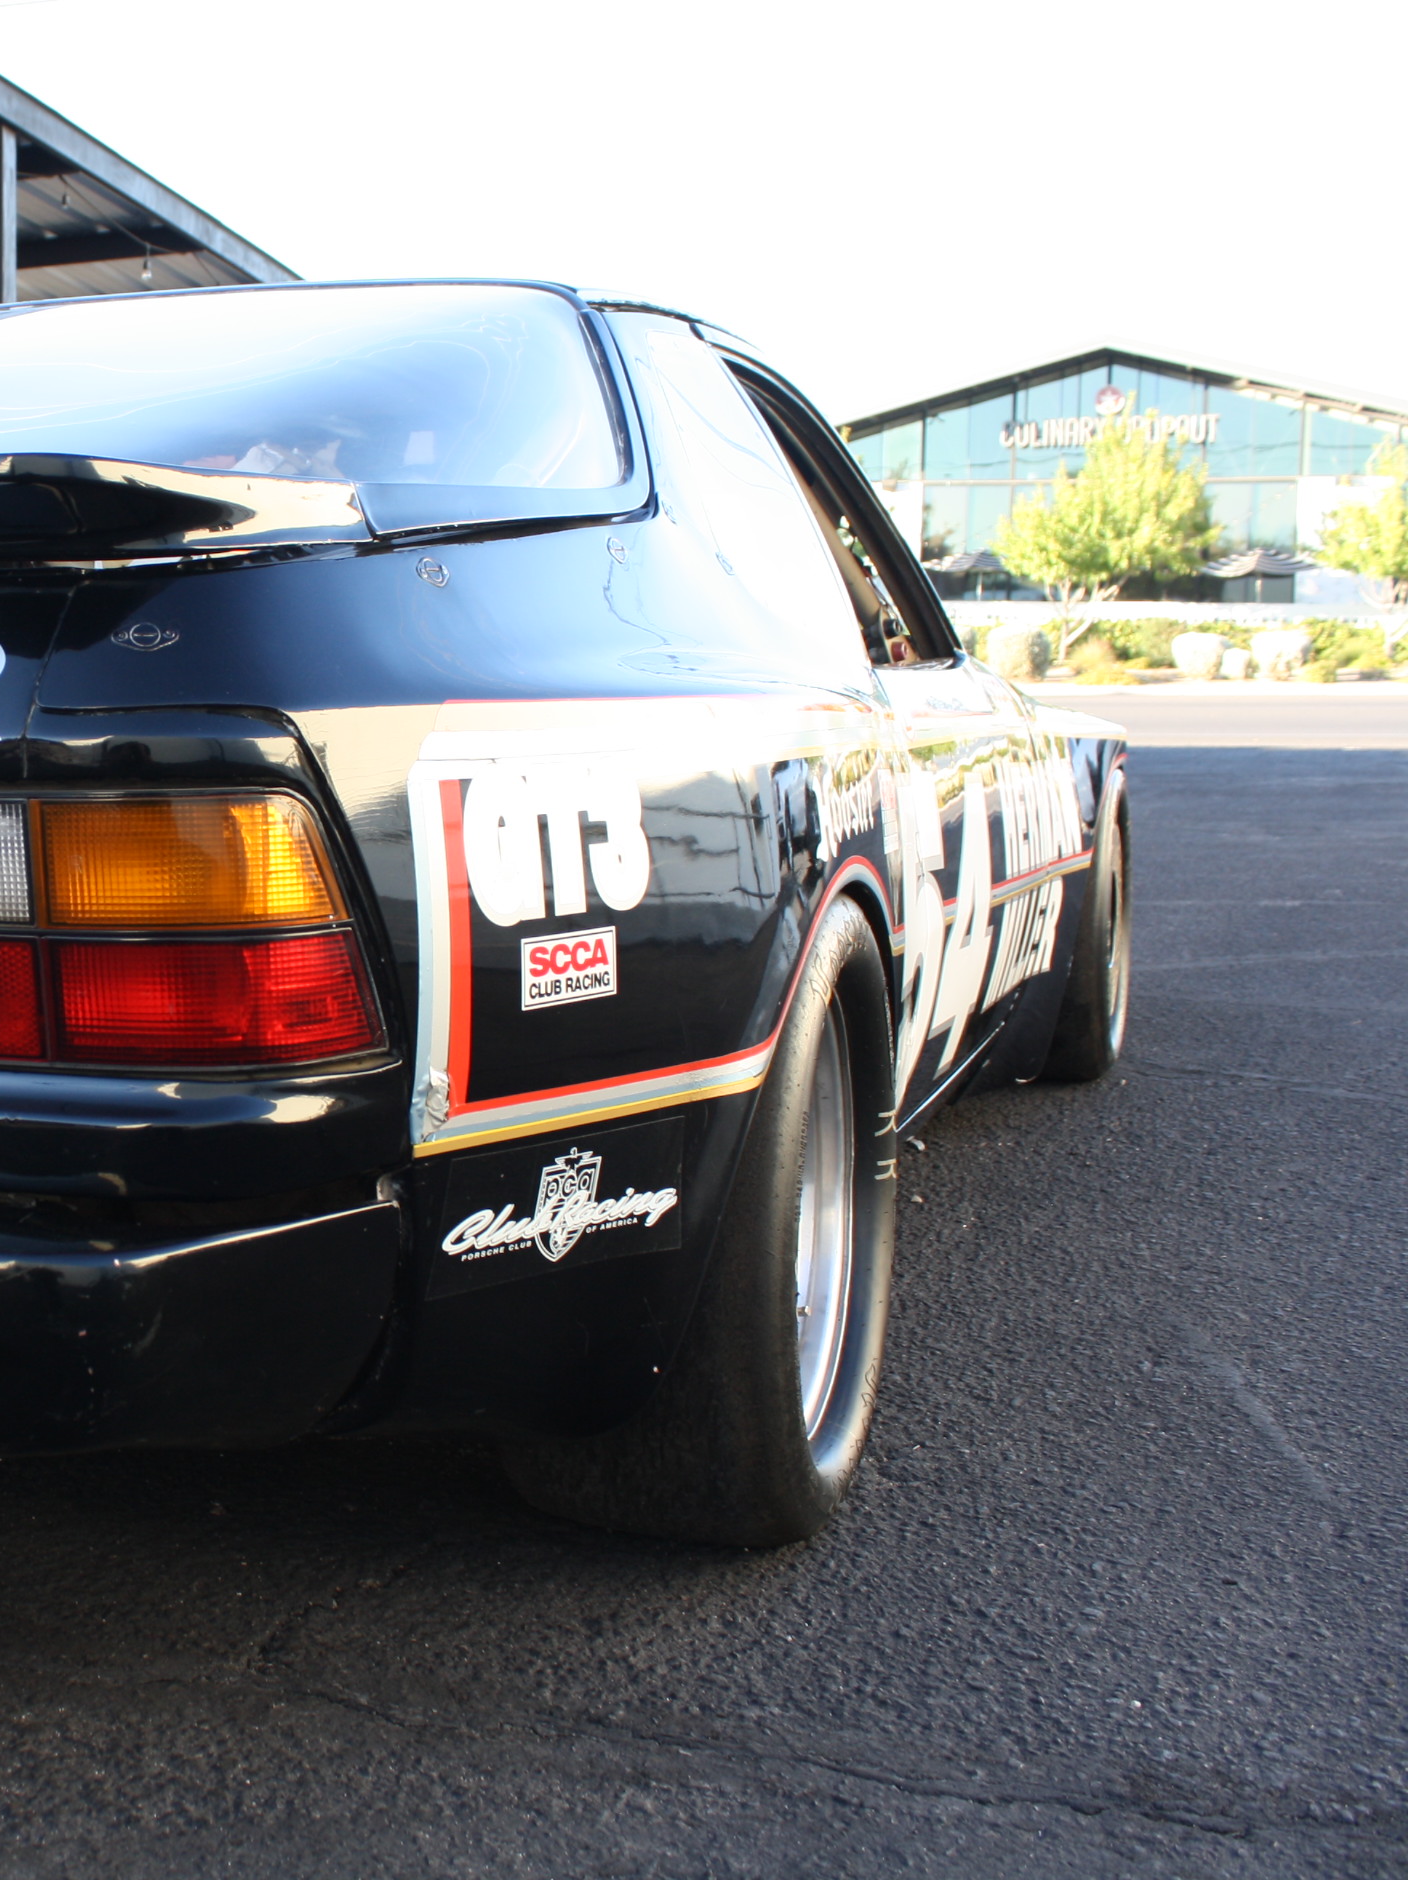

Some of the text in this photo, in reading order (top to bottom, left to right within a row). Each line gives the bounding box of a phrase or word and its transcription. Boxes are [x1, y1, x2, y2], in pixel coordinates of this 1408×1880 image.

[463, 760, 650, 926] GT3
[529, 938, 610, 978] SCCA
[894, 771, 994, 1108] 54
[529, 970, 610, 1000] CLUB RACING
[441, 1187, 678, 1256] Club Racing
[460, 1217, 639, 1262] PORSCHE CLUB OF AMERICA
